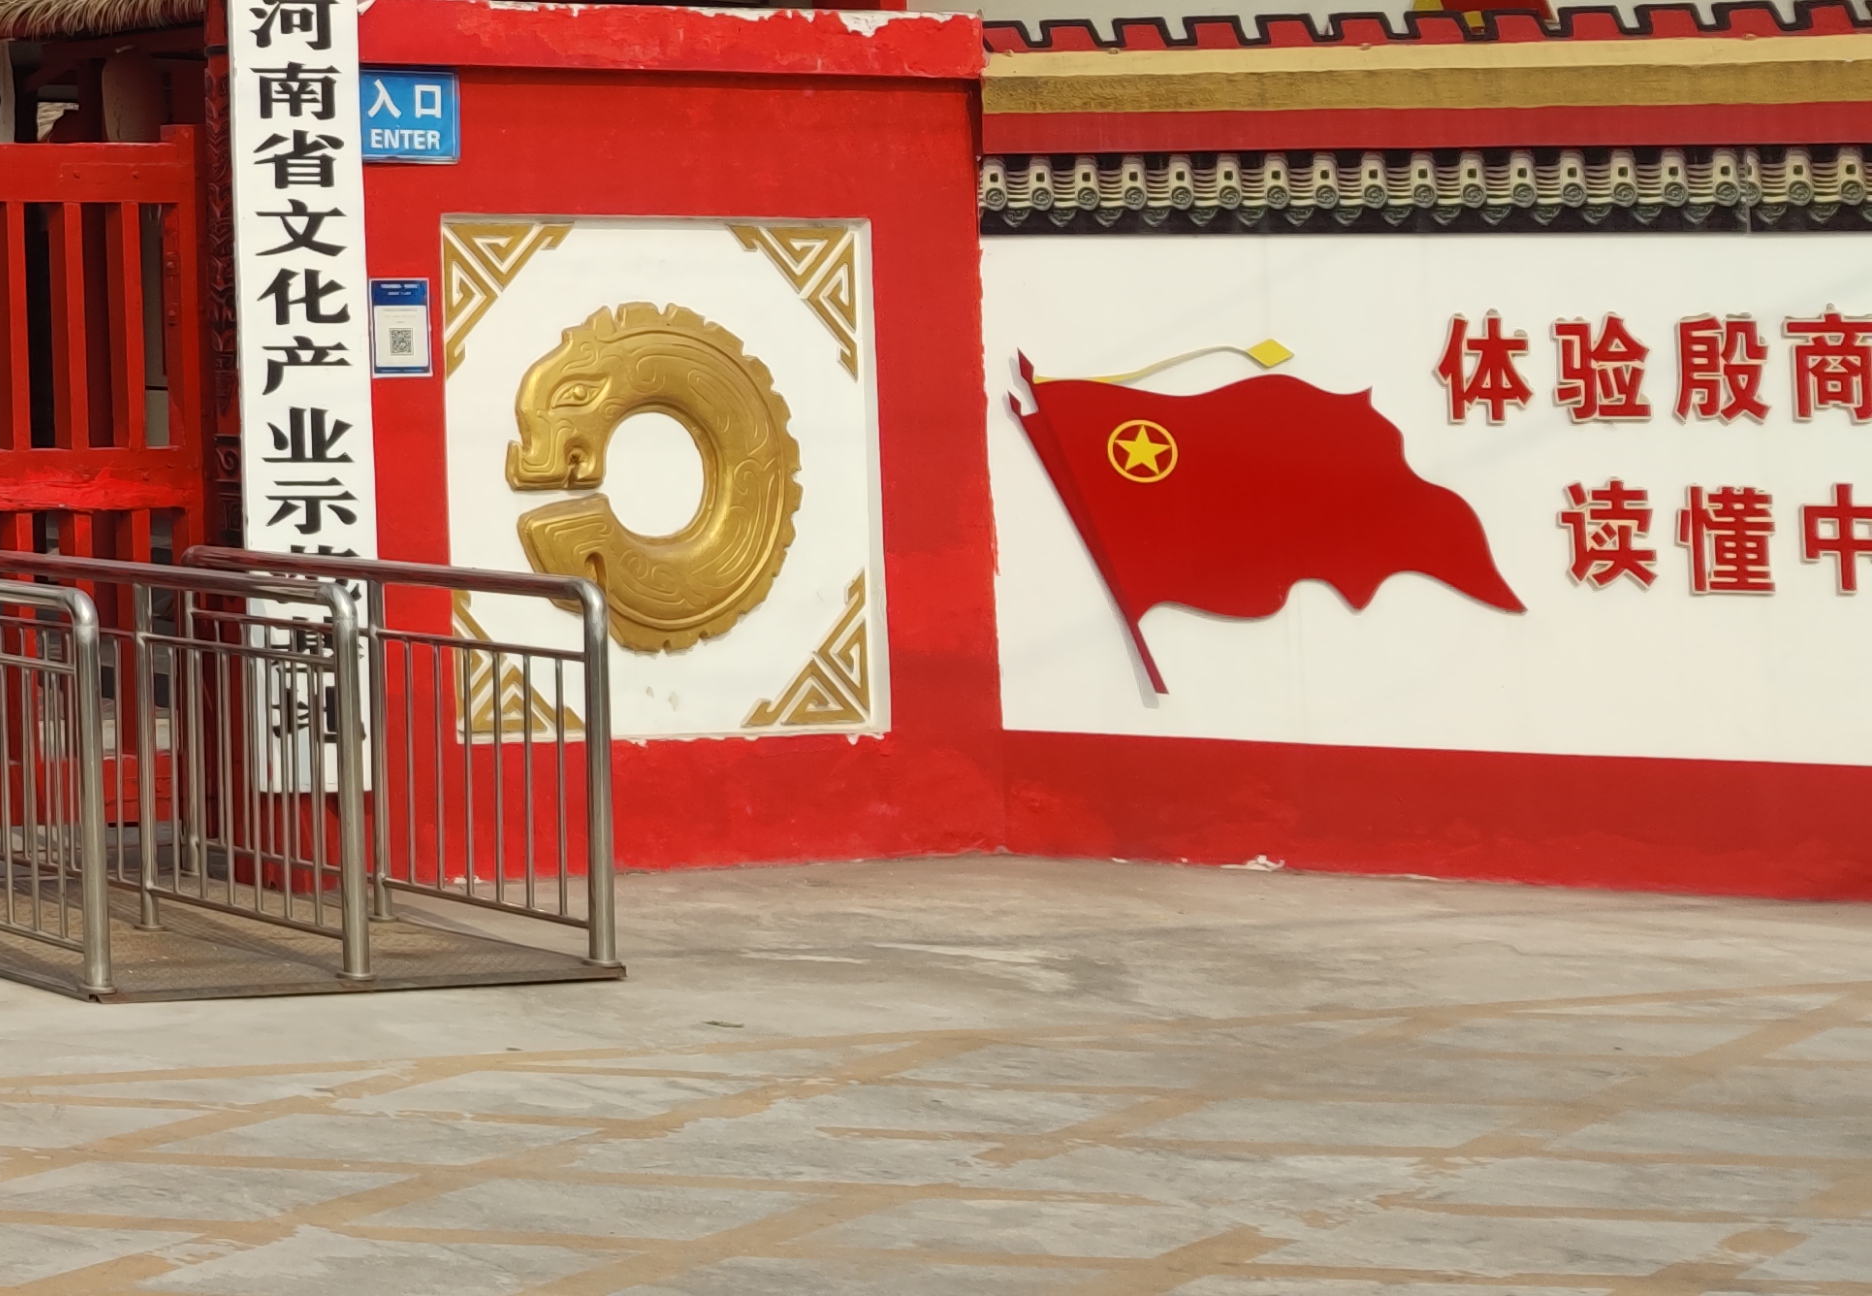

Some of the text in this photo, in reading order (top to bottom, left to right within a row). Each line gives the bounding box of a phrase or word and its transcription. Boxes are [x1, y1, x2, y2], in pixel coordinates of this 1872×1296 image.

[367, 79, 442, 119] 入口
[370, 128, 441, 151] ENTER
[1433, 303, 1872, 426] 体验殷商
[1555, 476, 1872, 596] 读懂中
